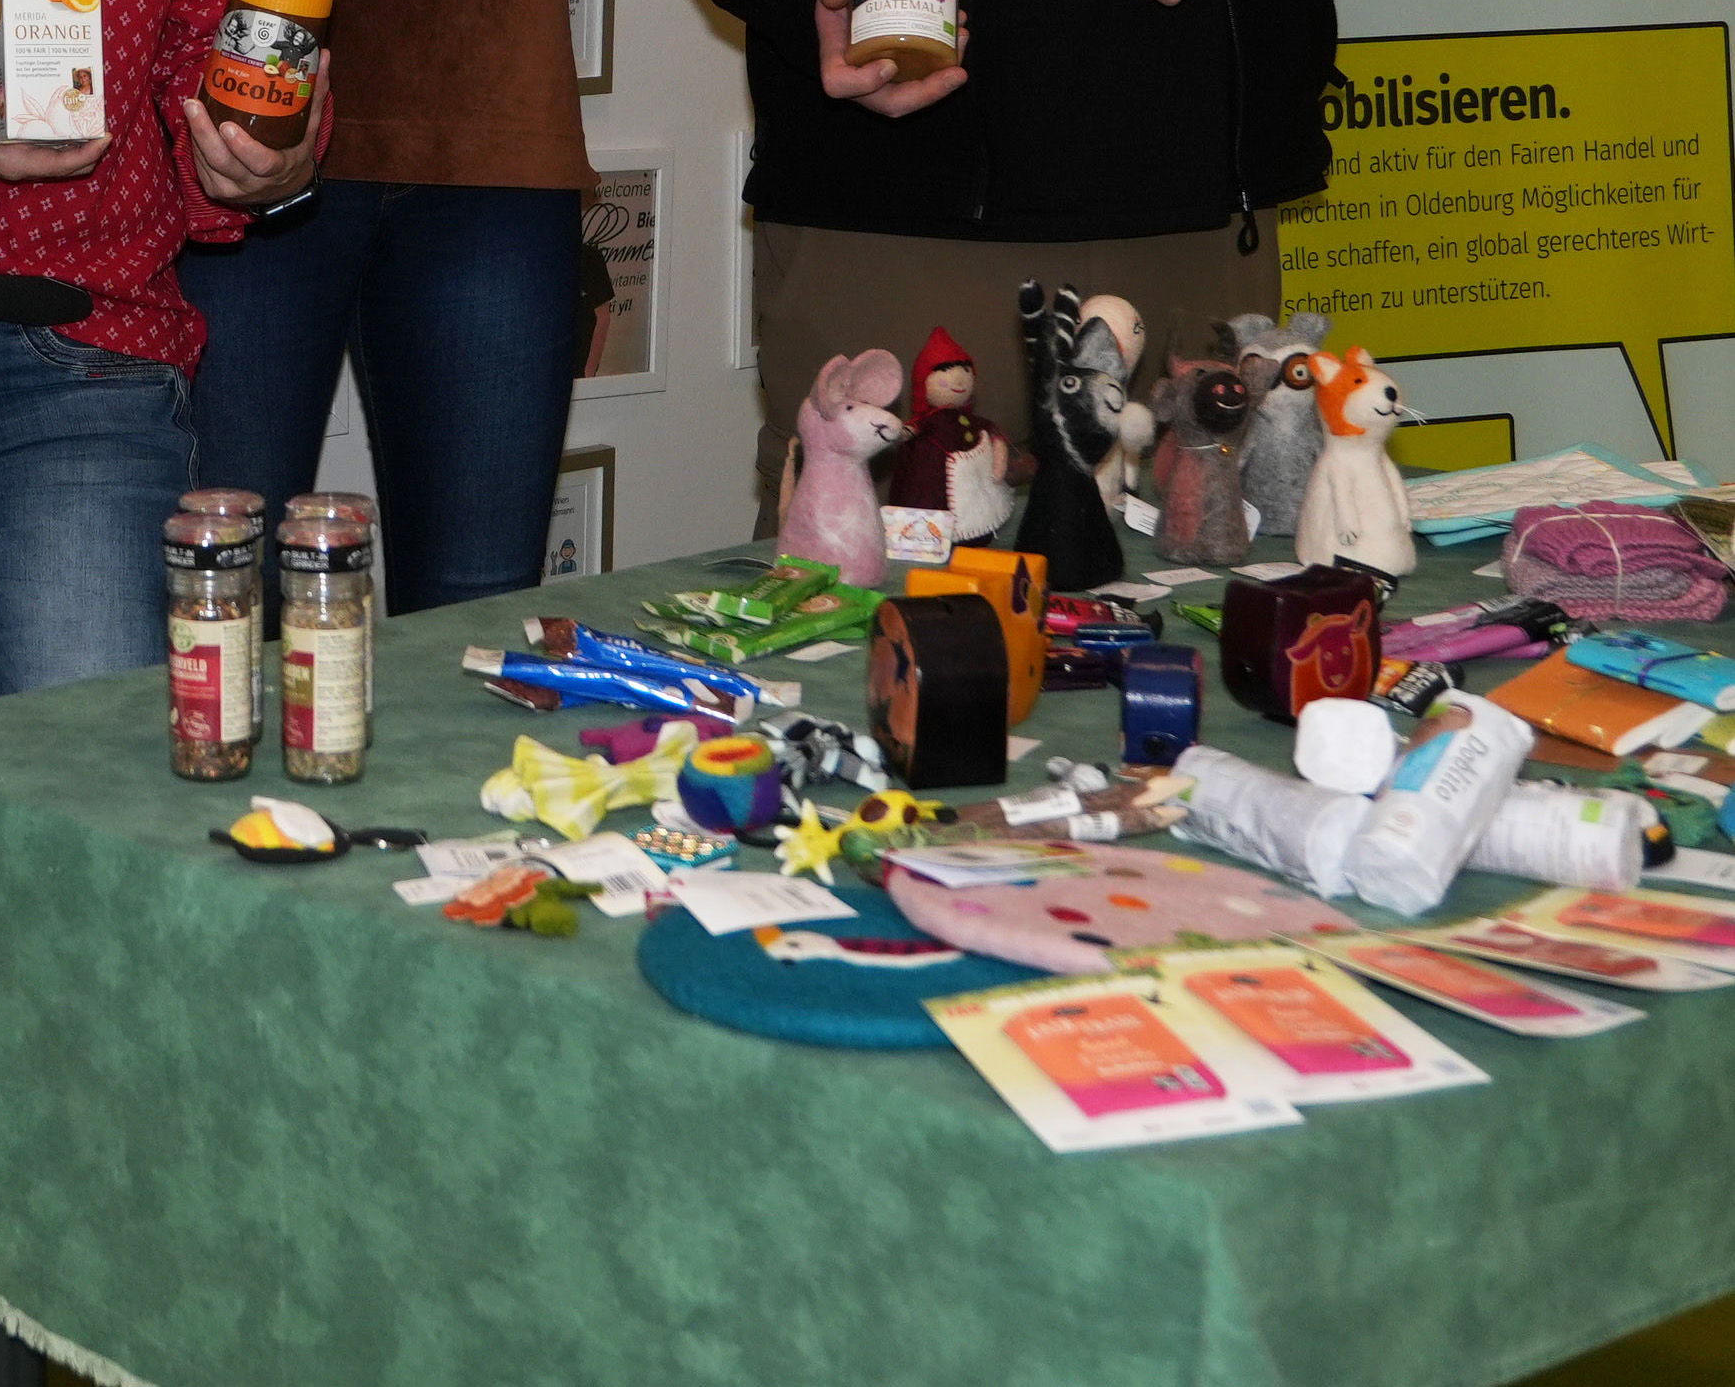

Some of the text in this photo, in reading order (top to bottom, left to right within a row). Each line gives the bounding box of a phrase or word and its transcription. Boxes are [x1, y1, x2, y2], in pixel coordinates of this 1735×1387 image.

[14, 12, 47, 21] MERIDA
[865, 0, 945, 17] GUATEMALA
[14, 24, 92, 40] ORANGE
[211, 67, 295, 107] Cocoba
[1369, 147, 1419, 174] aktiv
[1426, 145, 1456, 170] für
[1464, 144, 1502, 169] den
[1511, 141, 1574, 165] Fairen
[1584, 135, 1656, 162] Handel
[1663, 132, 1700, 157] und
[594, 179, 652, 198] welcome
[1279, 177, 1702, 225] möchten in Oldenburg Möglichkeiten für
[1281, 221, 1715, 271] alle schaffen, ein global gerechteres Wirt-
[1284, 277, 1551, 317] schaften zu unterstützen.
